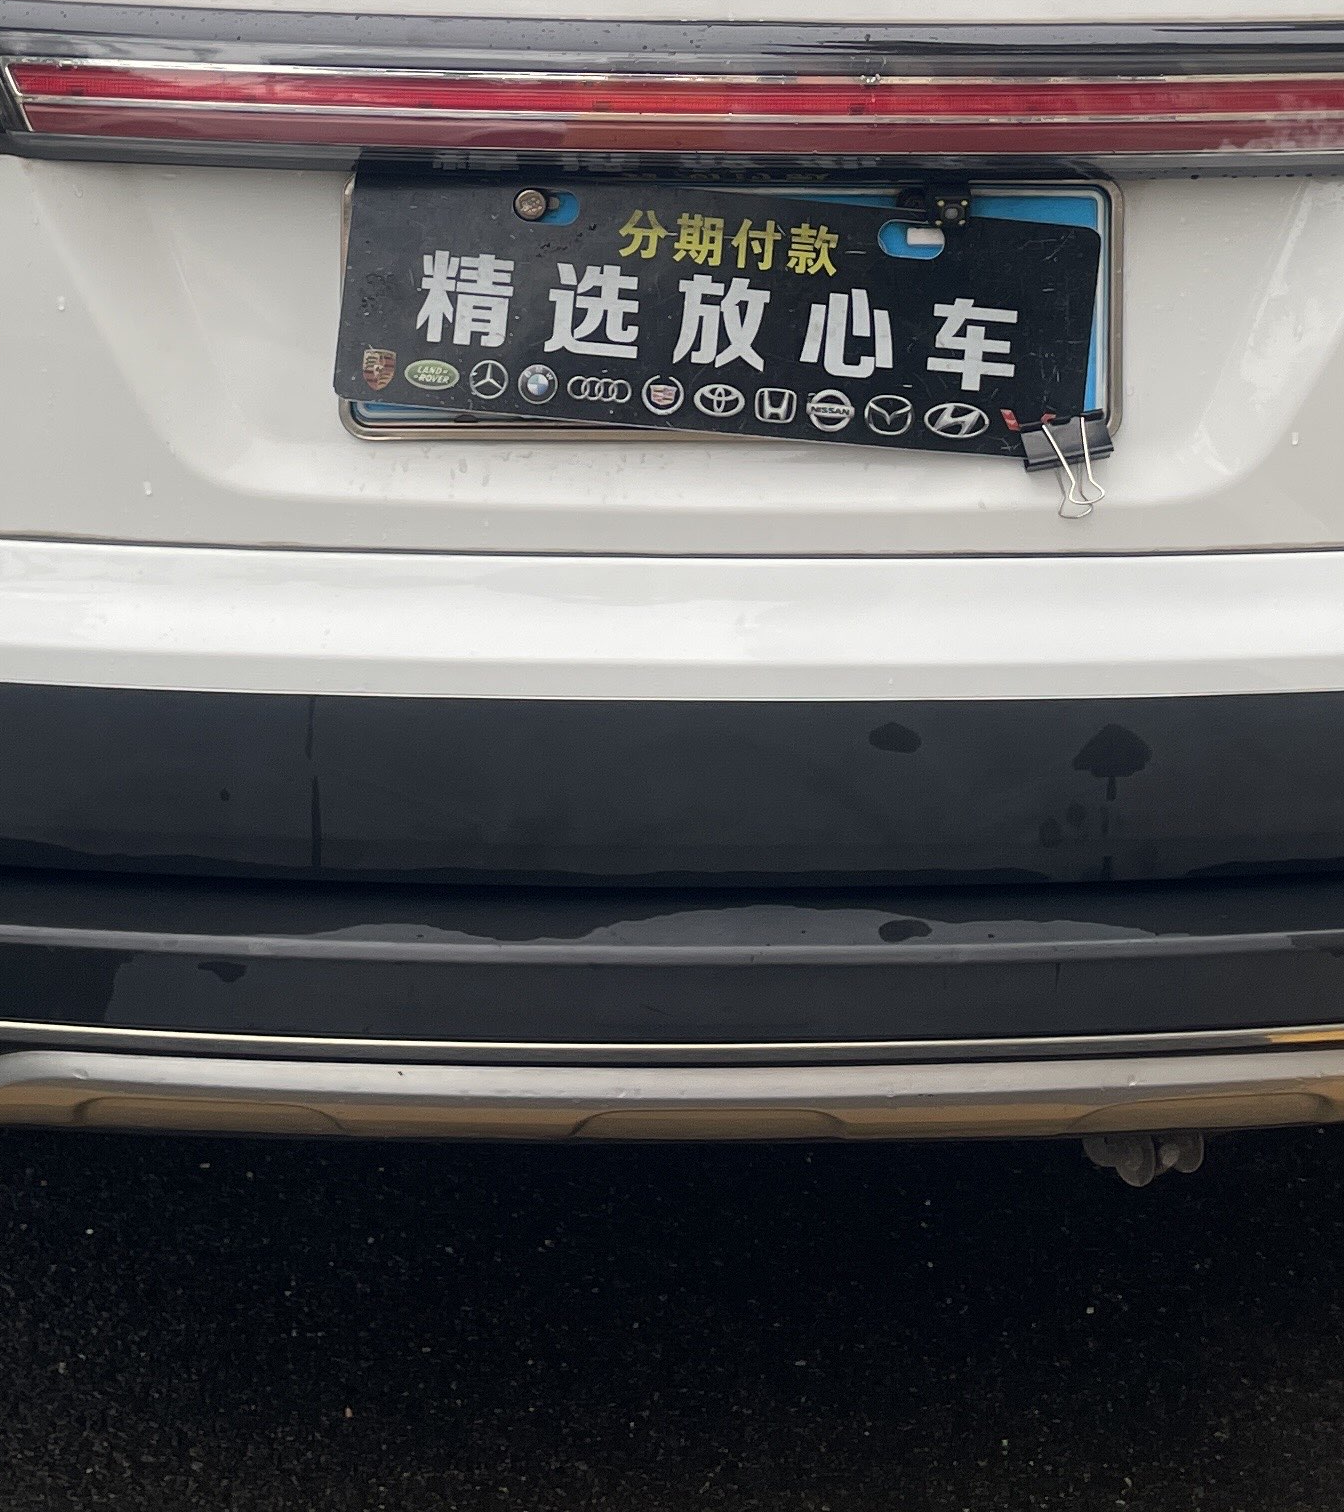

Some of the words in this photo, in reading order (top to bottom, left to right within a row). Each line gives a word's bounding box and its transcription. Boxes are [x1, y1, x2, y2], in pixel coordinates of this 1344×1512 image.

[620, 210, 839, 276] 分期付款
[416, 251, 1019, 392] 精选放心车
[418, 373, 451, 384] ROVER
[810, 404, 851, 416] NISSAN
